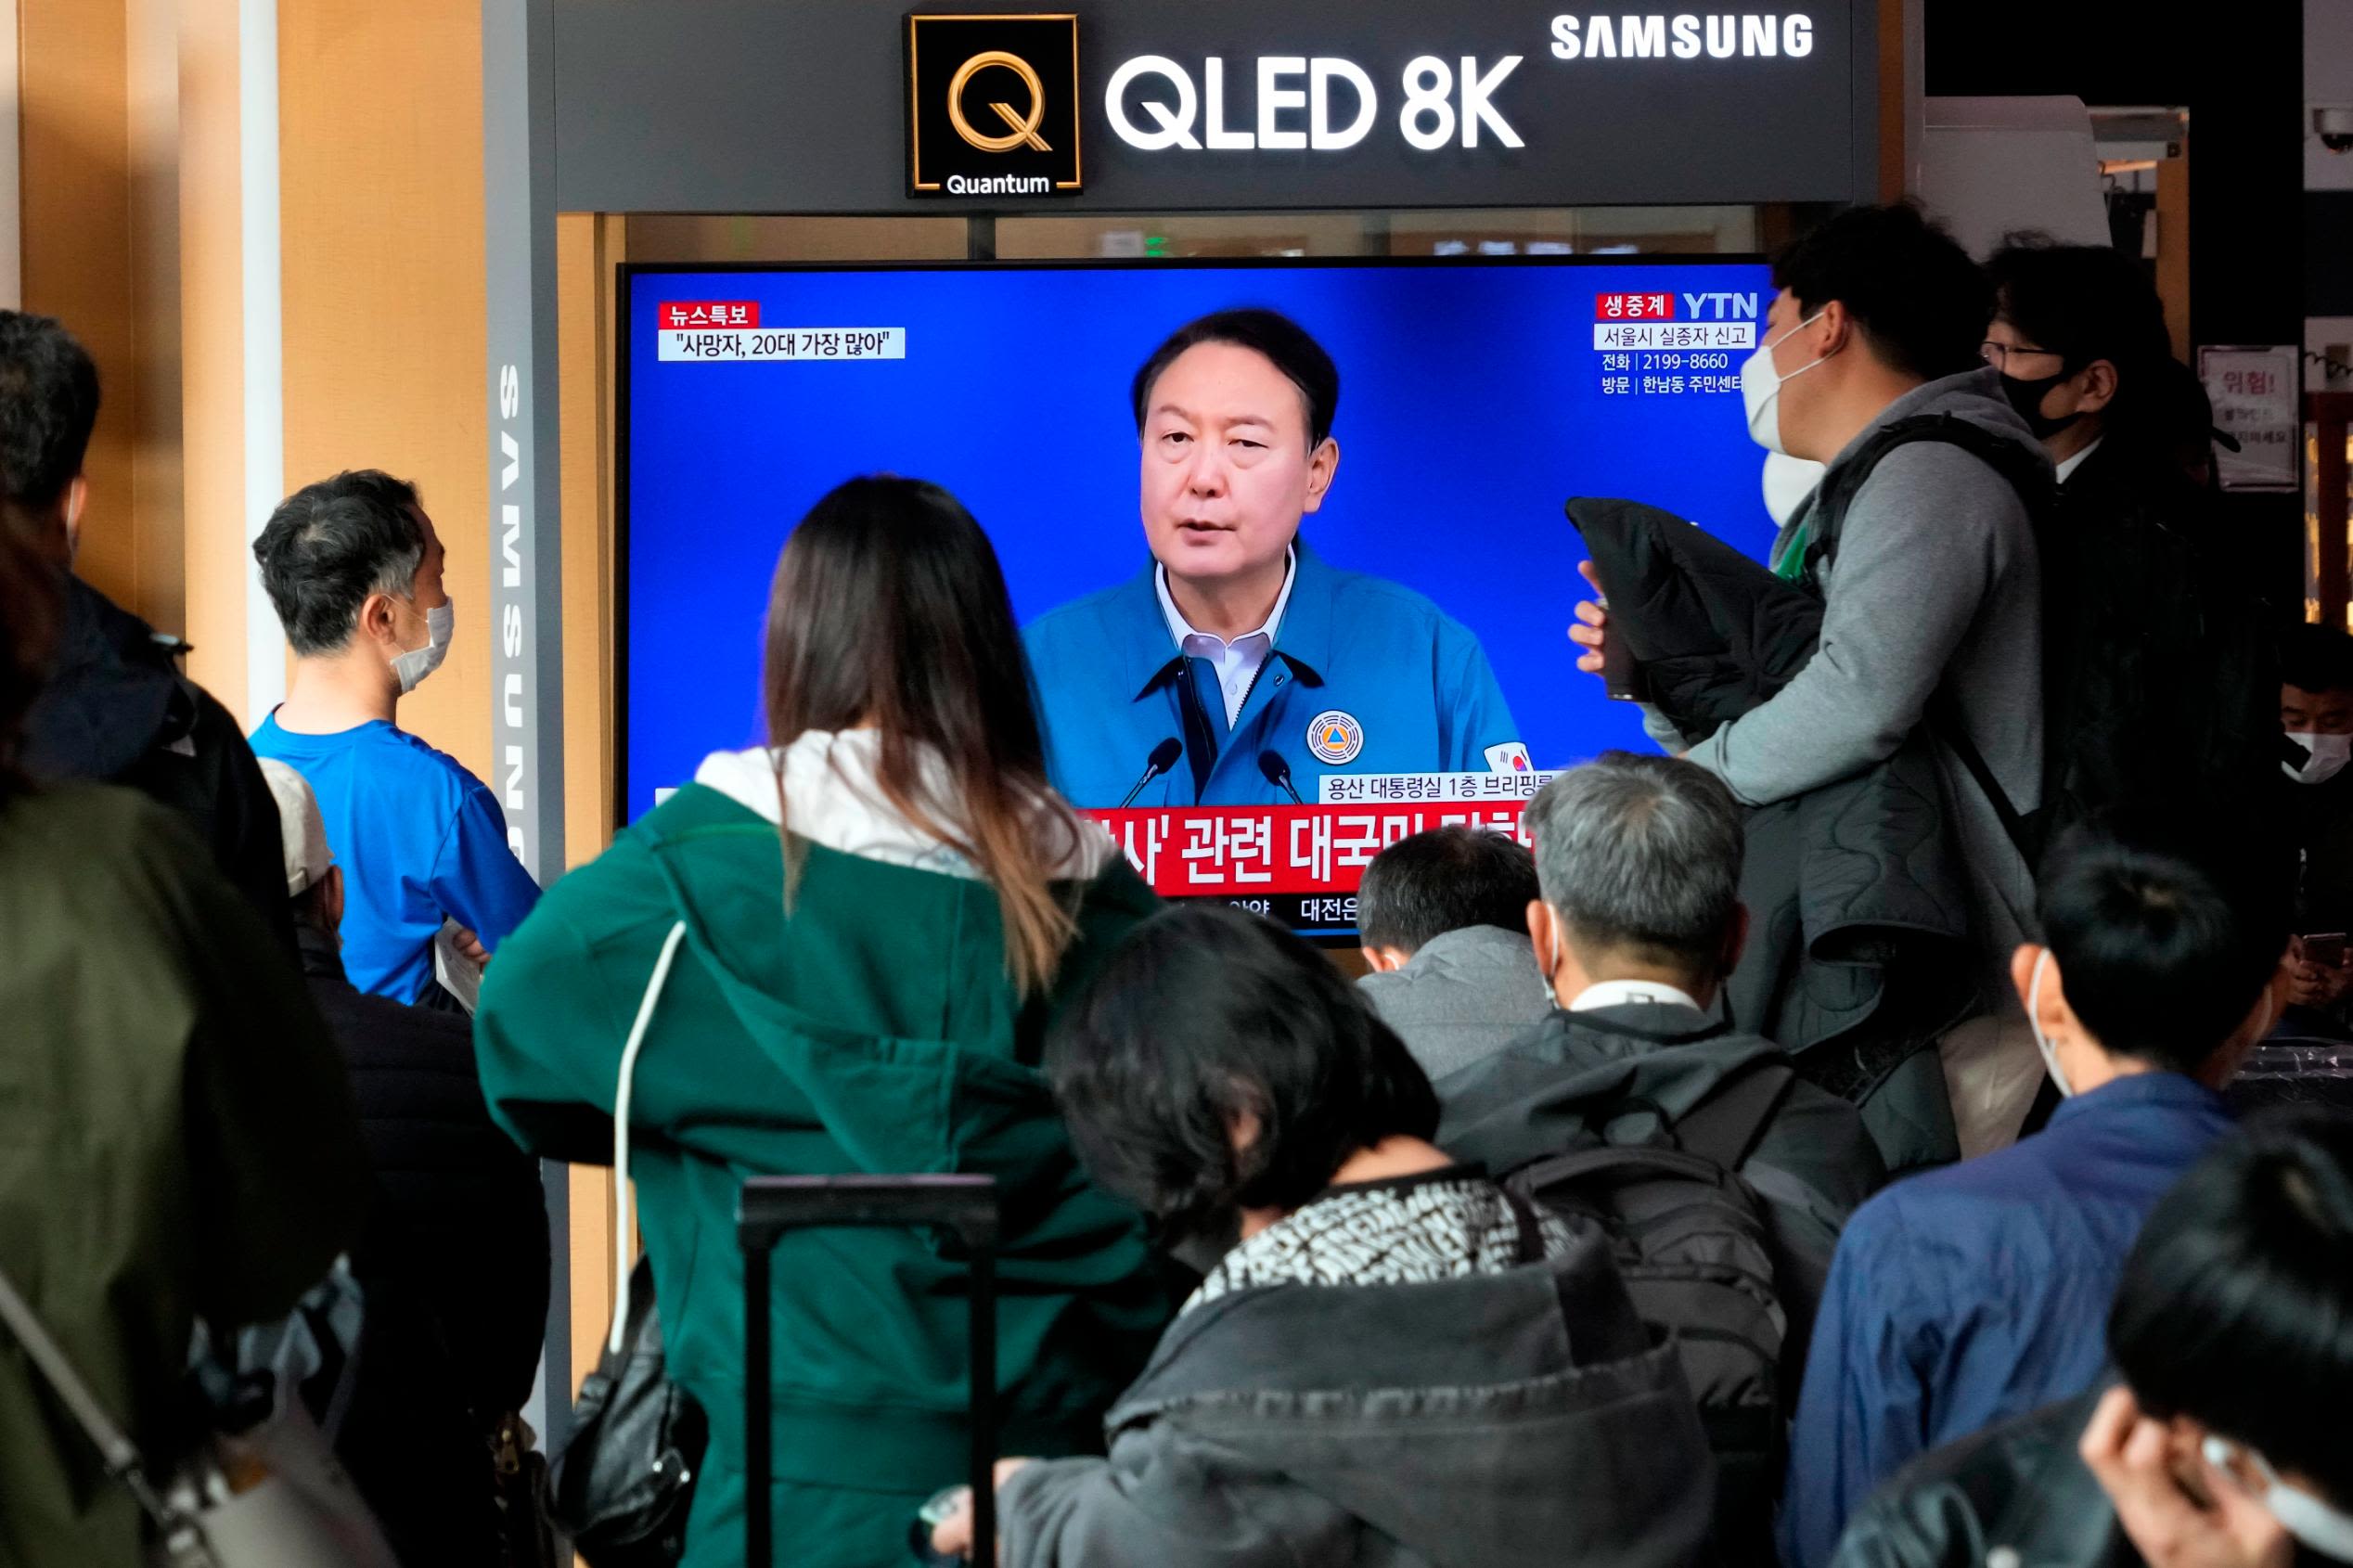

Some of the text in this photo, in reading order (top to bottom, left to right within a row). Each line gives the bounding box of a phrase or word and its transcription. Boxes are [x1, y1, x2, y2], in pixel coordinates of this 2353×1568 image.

[1550, 14, 1813, 59] SAMSUNG
[946, 50, 1053, 152] Q
[1104, 56, 1525, 150] QLED 8K
[946, 174, 1049, 198] Quantum
[669, 305, 749, 326] 뉴스특보
[1604, 295, 1665, 317] 생중계
[1682, 293, 1757, 319] YTN
[676, 331, 890, 359] "사망자, 20대 가장 많아"
[1604, 326, 1747, 347] 서울시 실종자 신고
[1602, 353, 1729, 371] 전화 2199-8660
[1602, 376, 1743, 393] 방문 한남동 주민센터
[1329, 778, 1364, 800] 용산
[1370, 777, 1441, 799] 대통령실
[1449, 777, 1477, 798] 1층
[1106, 814, 1169, 886] 사'
[1181, 816, 1272, 885] 관련
